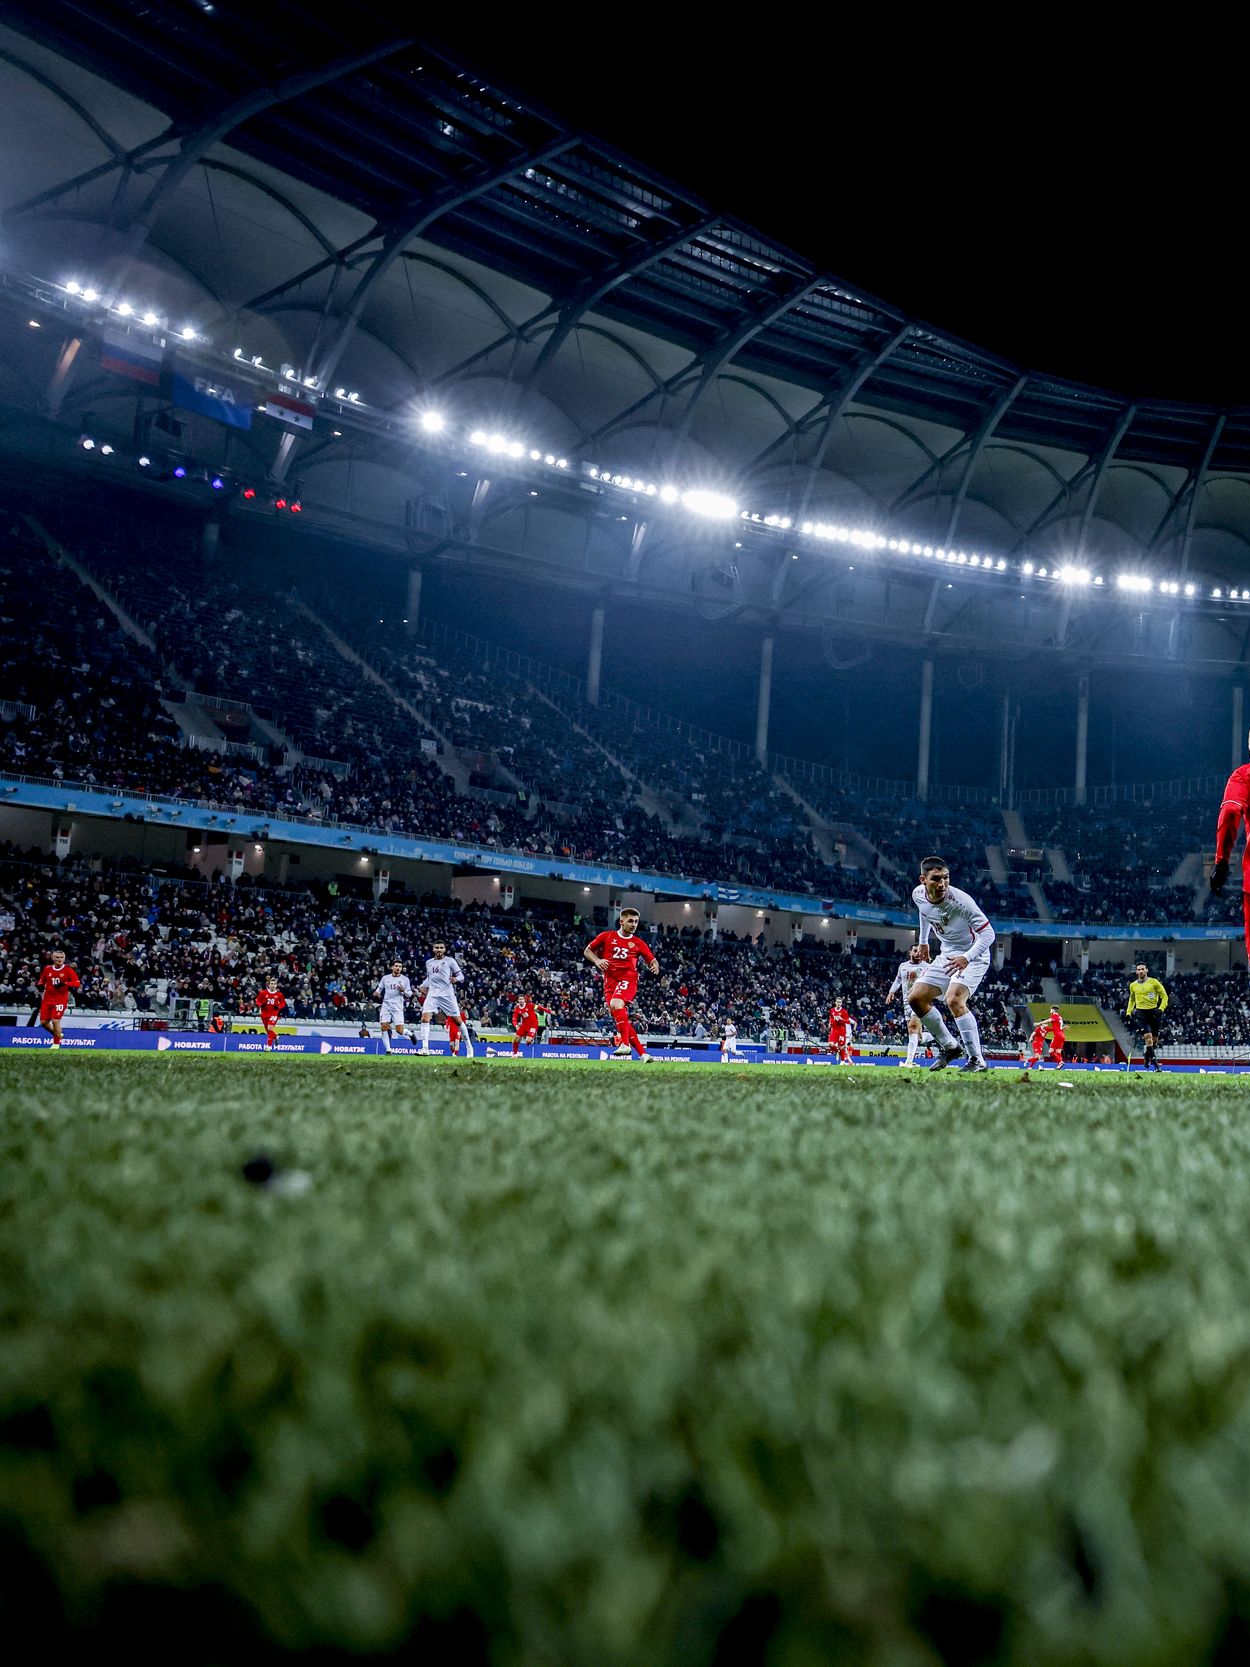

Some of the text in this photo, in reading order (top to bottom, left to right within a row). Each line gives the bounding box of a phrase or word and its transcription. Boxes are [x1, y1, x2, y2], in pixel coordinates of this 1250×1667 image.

[194, 376, 235, 405] FIFA
[612, 947, 629, 960] 23
[432, 966, 439, 974] 16
[51, 977, 61, 986] 10
[55, 1004, 64, 1012] 10
[12, 1036, 42, 1045] РАБОТА
[43, 1037, 54, 1045] НА
[174, 1041, 211, 1049] НОВАТЭК
[334, 1045, 366, 1053] НОВАТЭК
